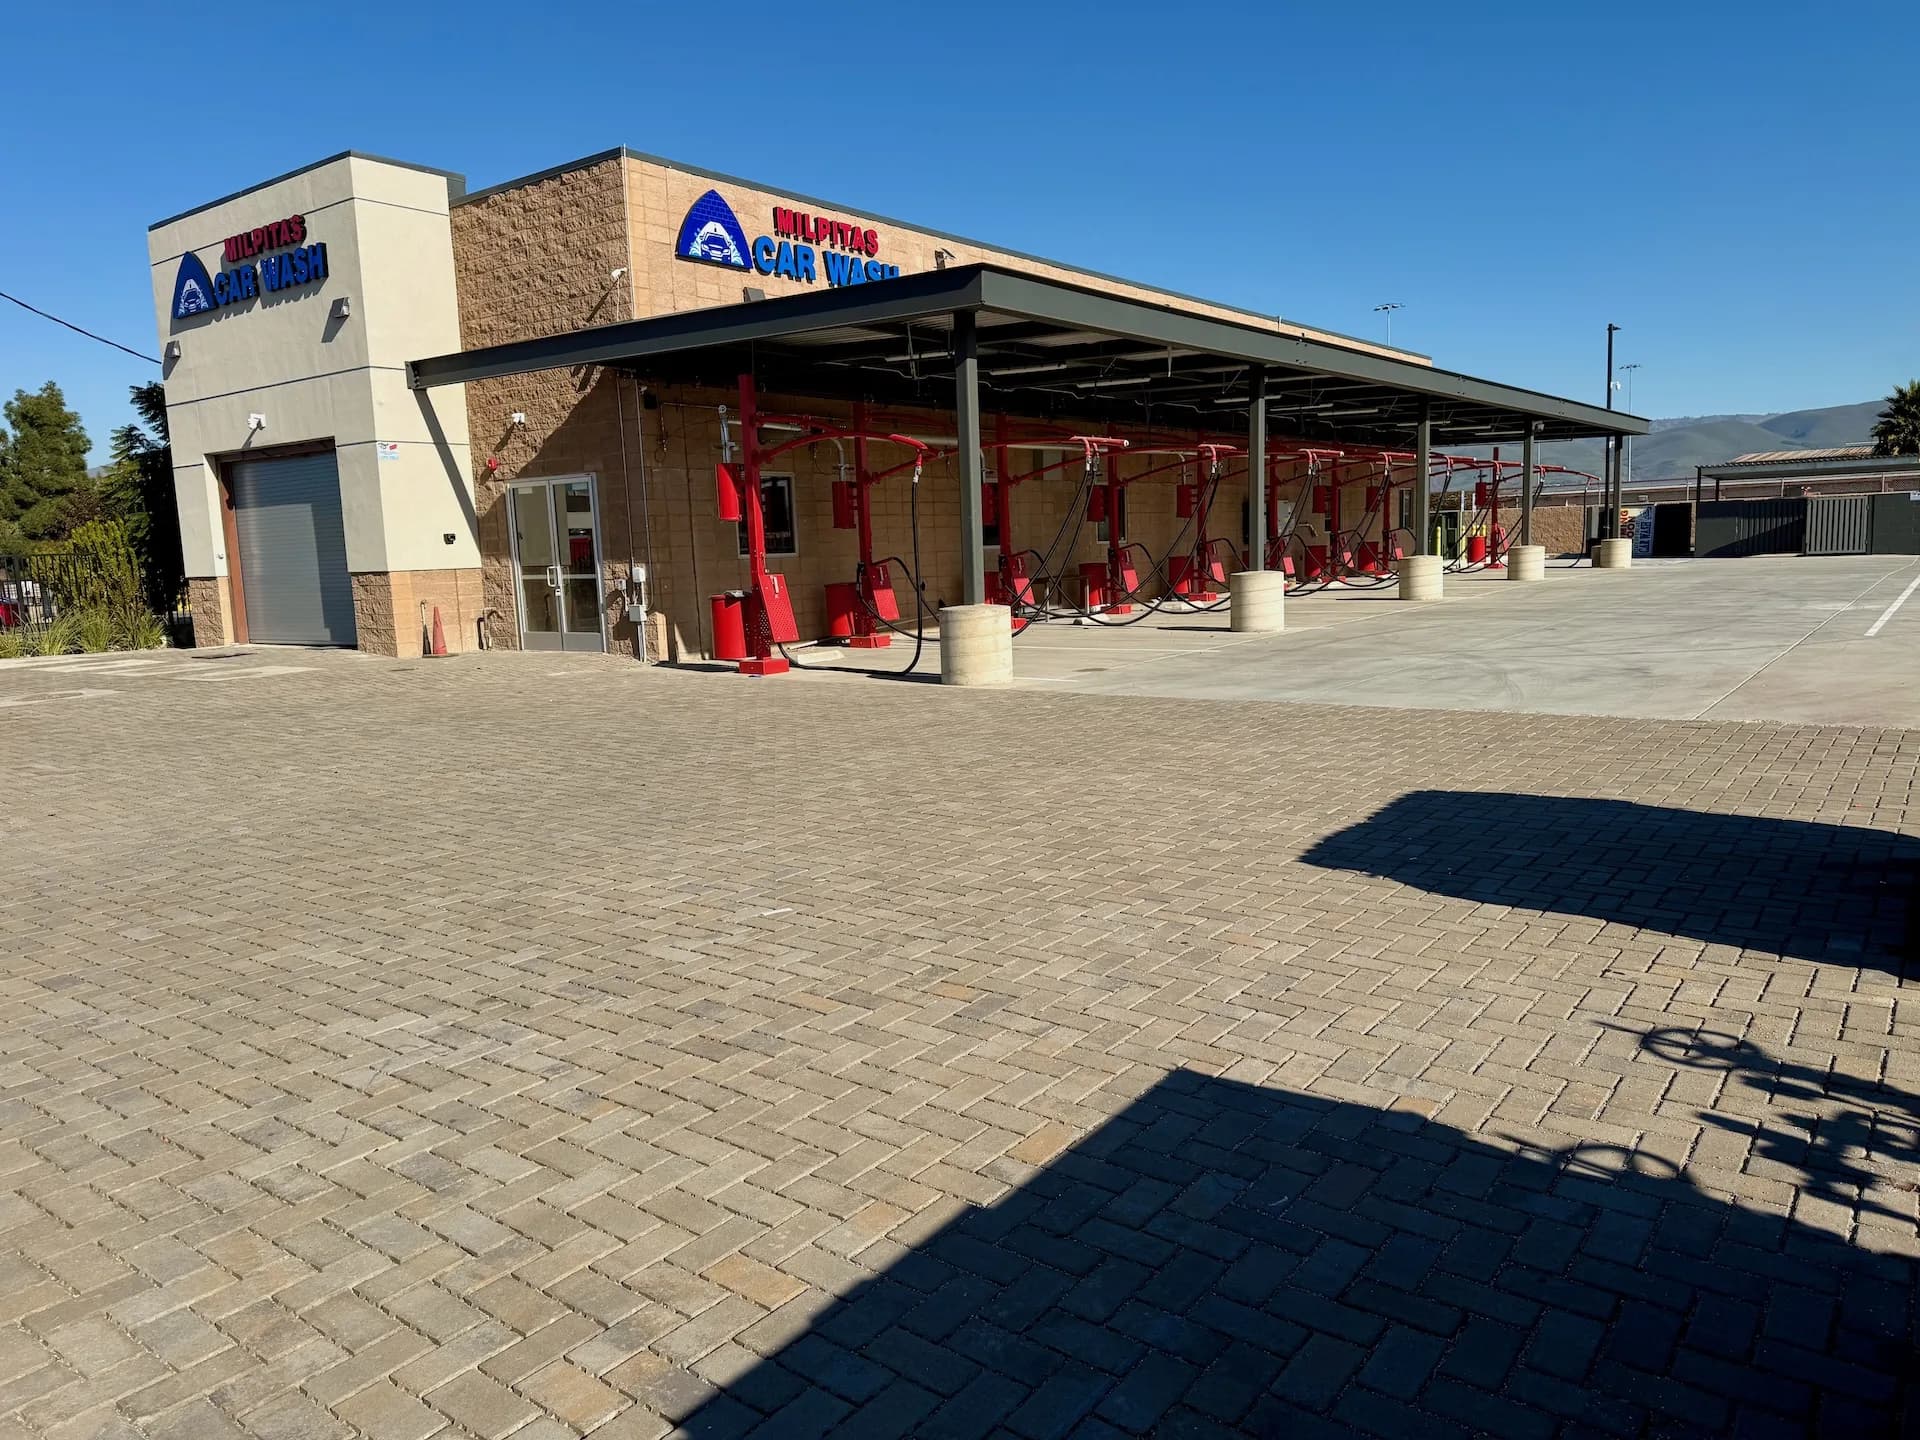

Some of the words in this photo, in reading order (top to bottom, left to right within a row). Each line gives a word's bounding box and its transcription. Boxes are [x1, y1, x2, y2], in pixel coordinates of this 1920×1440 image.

[224, 214, 306, 262] MILPITAS
[773, 207, 878, 256] MILPITAS
[214, 264, 259, 305] CAR
[260, 242, 328, 292] WASH
[753, 236, 816, 281] CAR
